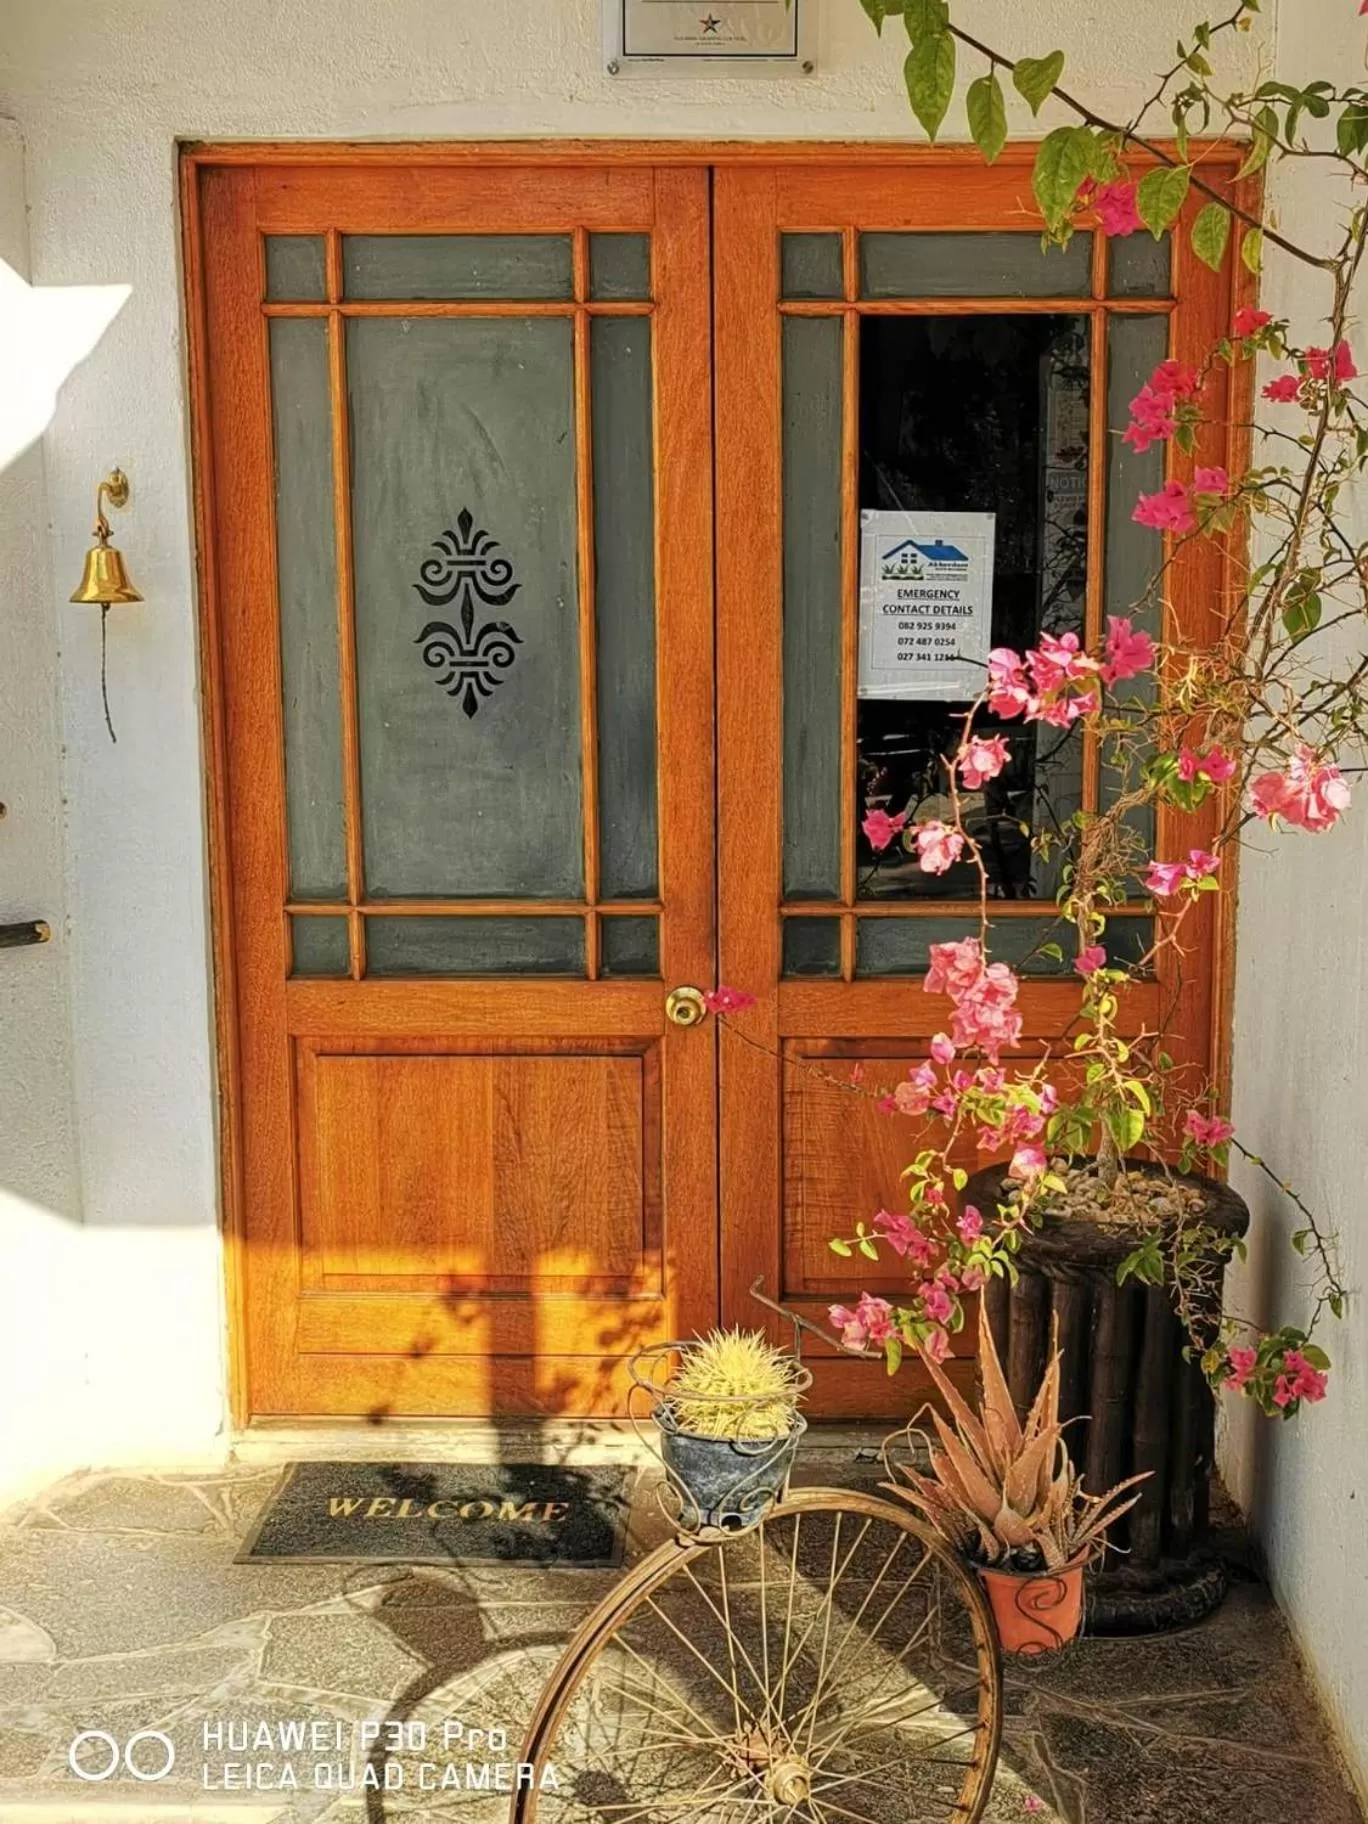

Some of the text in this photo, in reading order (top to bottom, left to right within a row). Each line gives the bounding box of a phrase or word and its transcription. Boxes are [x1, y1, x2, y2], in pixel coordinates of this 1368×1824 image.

[897, 589, 960, 599] EMERGENCY
[882, 604, 973, 615] CONTACT DETAILS
[898, 621, 915, 630] 082
[916, 622, 933, 630] 925
[897, 637, 914, 646] 072
[916, 637, 932, 646] 487
[897, 652, 914, 661] 027
[916, 653, 931, 661] 341
[328, 1497, 570, 1522] WELCOME
